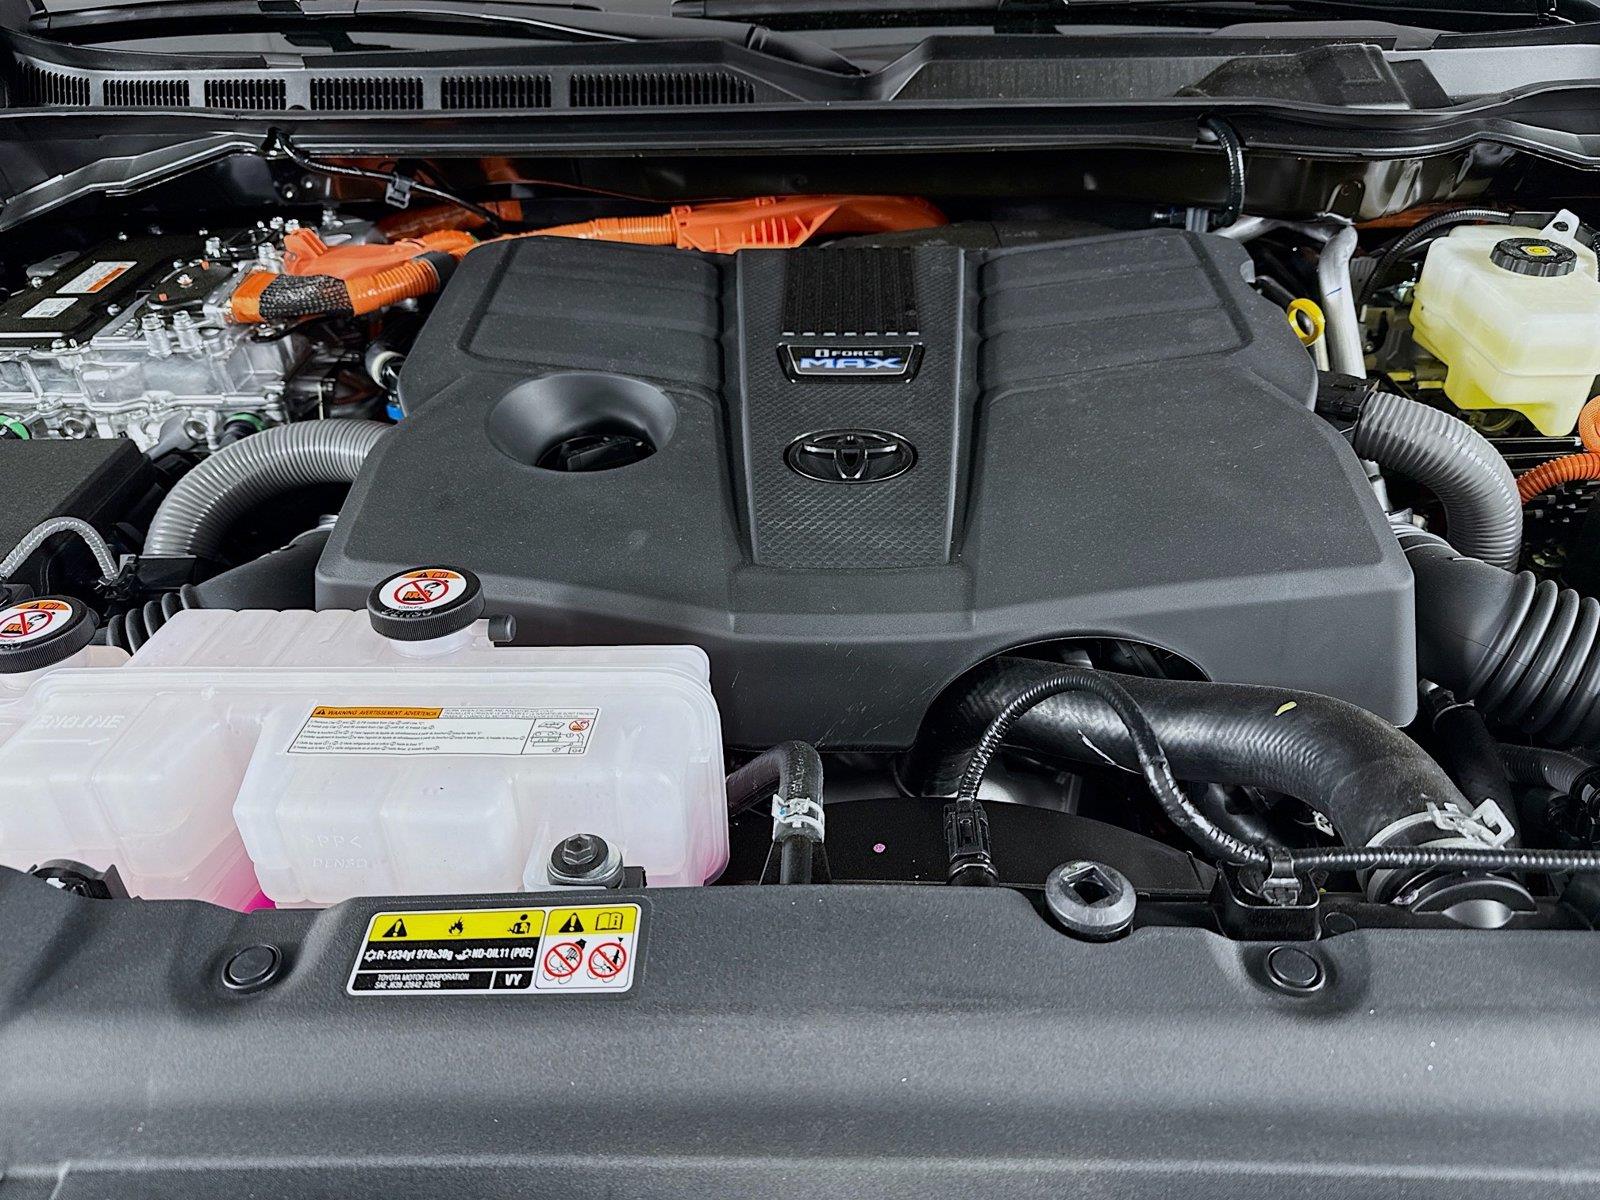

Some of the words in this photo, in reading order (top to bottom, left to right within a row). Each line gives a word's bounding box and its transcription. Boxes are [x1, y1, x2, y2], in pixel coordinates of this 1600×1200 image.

[800, 357, 902, 369] MAX
[510, 947, 534, 960] (POE)
[401, 973, 425, 981] MOTOR
[505, 973, 523, 986] VY
